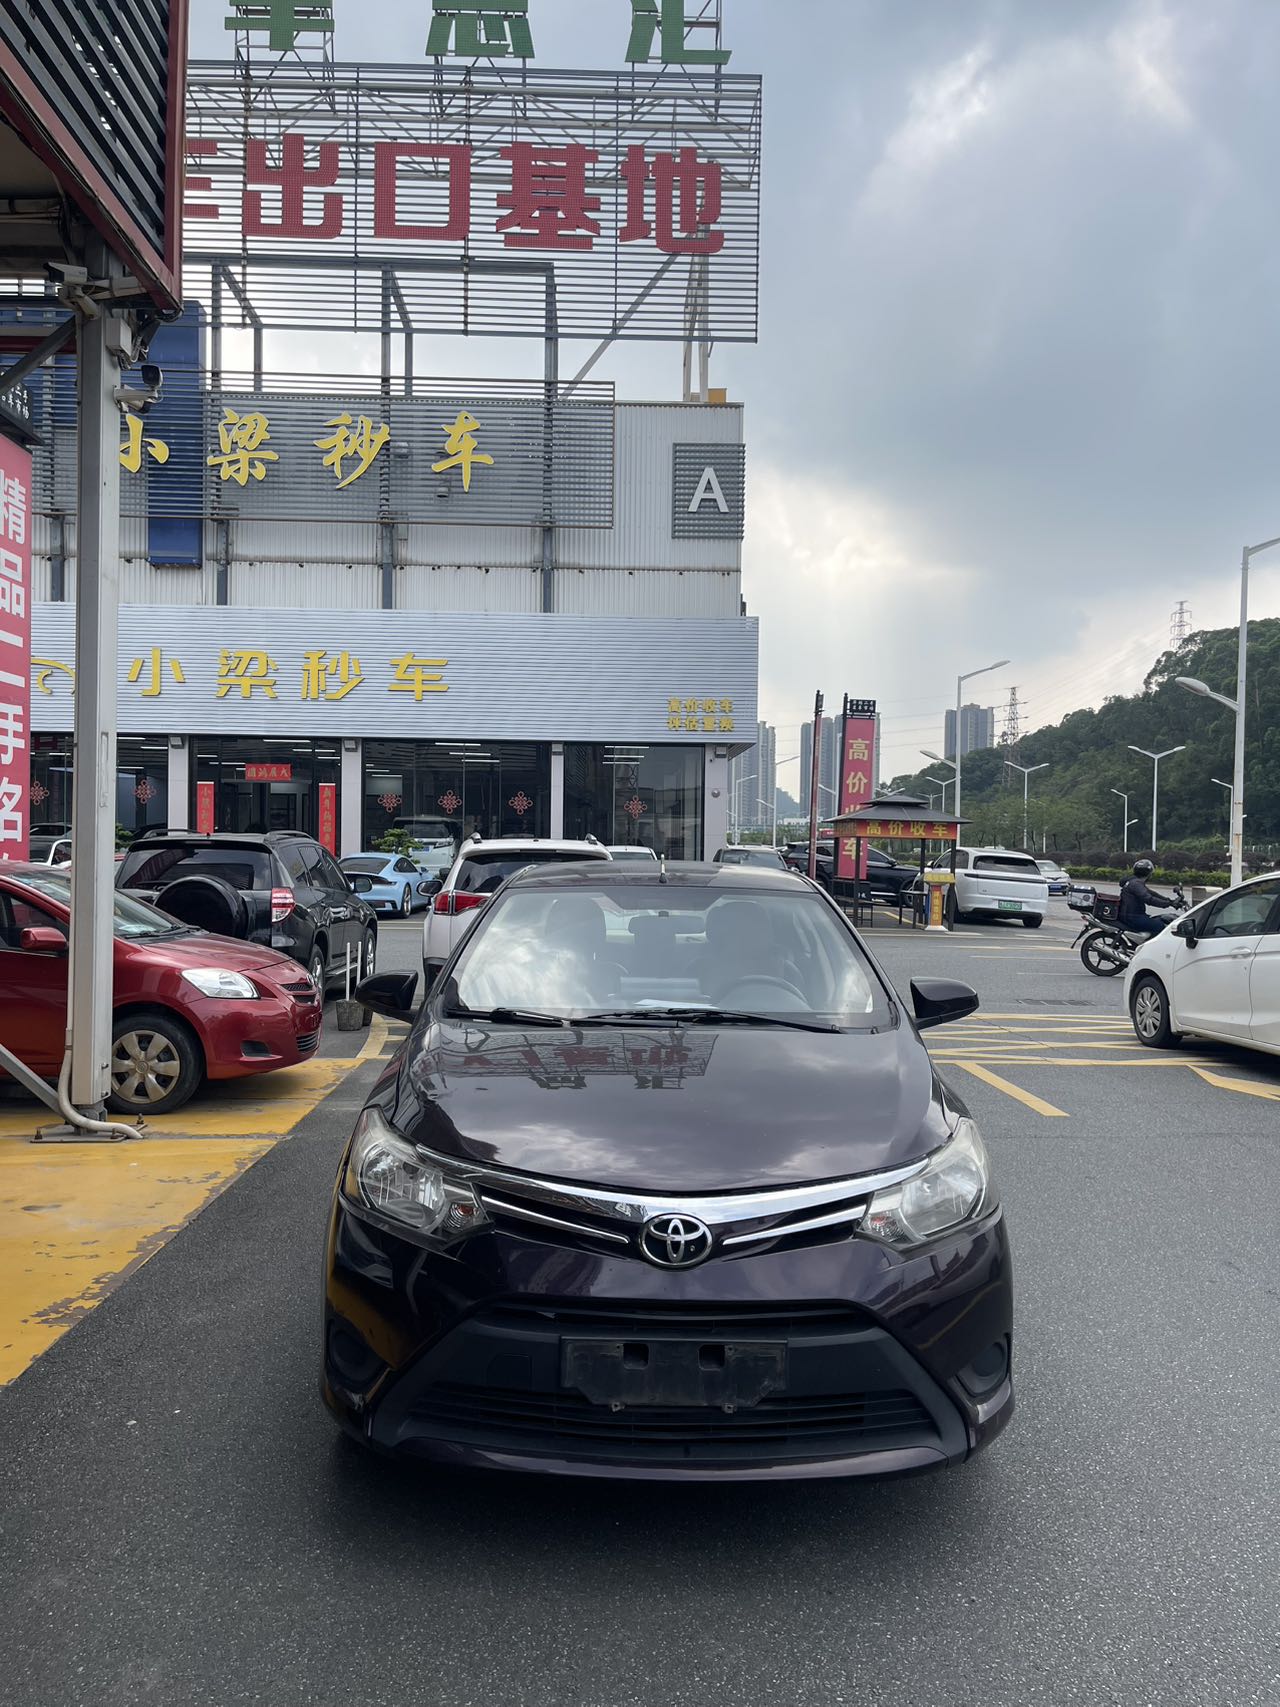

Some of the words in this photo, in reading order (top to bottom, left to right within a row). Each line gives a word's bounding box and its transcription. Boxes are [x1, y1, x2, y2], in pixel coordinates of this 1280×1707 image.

[119, 407, 495, 493] 小梁秒车
[687, 466, 730, 513] A
[0, 471, 26, 863] 精品二手名
[127, 647, 450, 701] 小梁秒车
[866, 820, 948, 836] 高价收车
